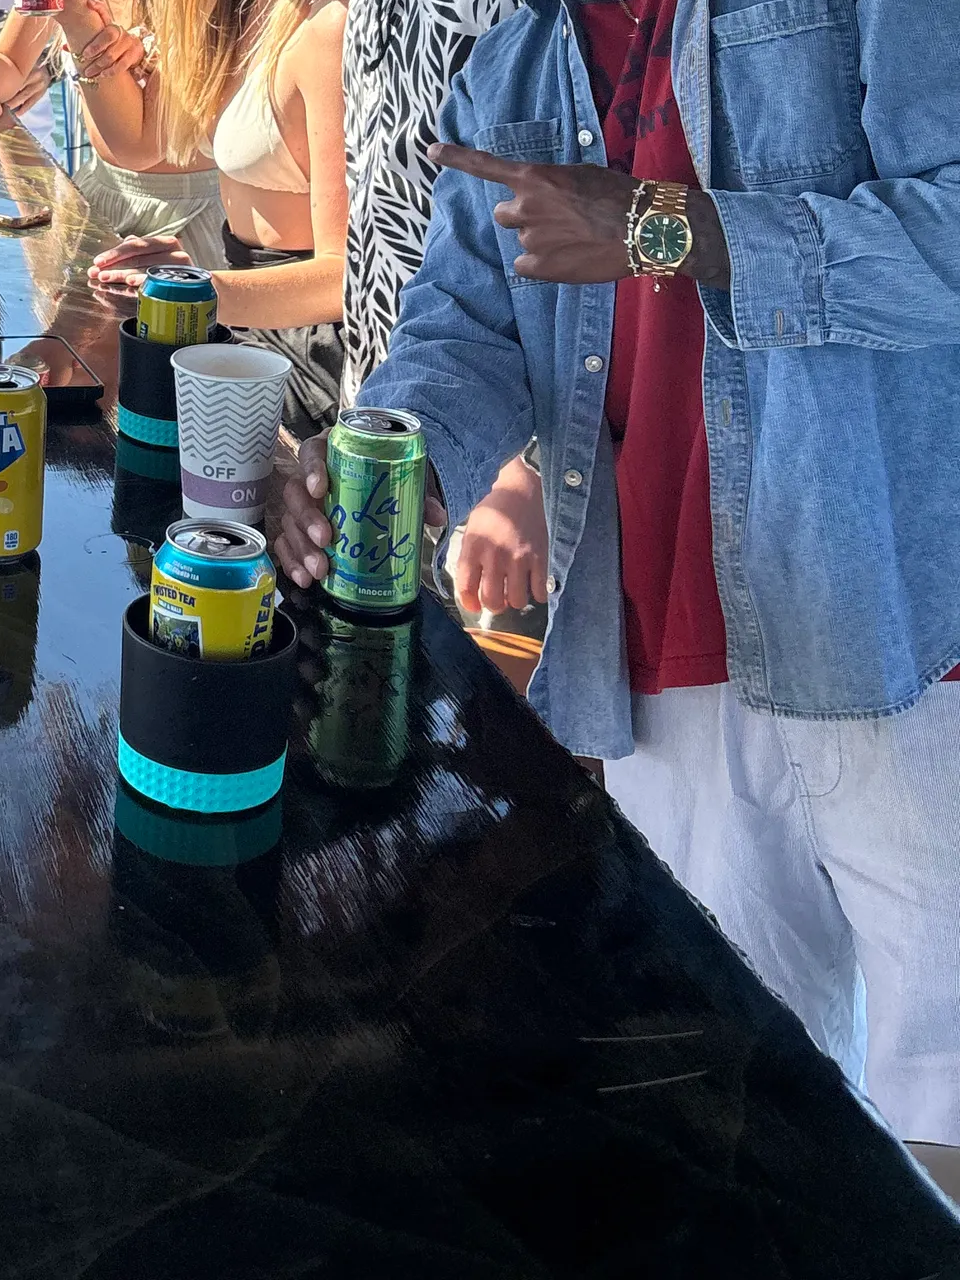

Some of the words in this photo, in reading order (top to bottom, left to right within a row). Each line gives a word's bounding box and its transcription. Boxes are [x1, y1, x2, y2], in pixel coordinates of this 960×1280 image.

[202, 465, 237, 480] OFF
[231, 487, 257, 503] ON
[351, 471, 401, 532] La
[5, 532, 19, 541] 180
[178, 591, 197, 608] TEA
[358, 587, 396, 597] INNOCENT
[253, 590, 274, 638] TEA
